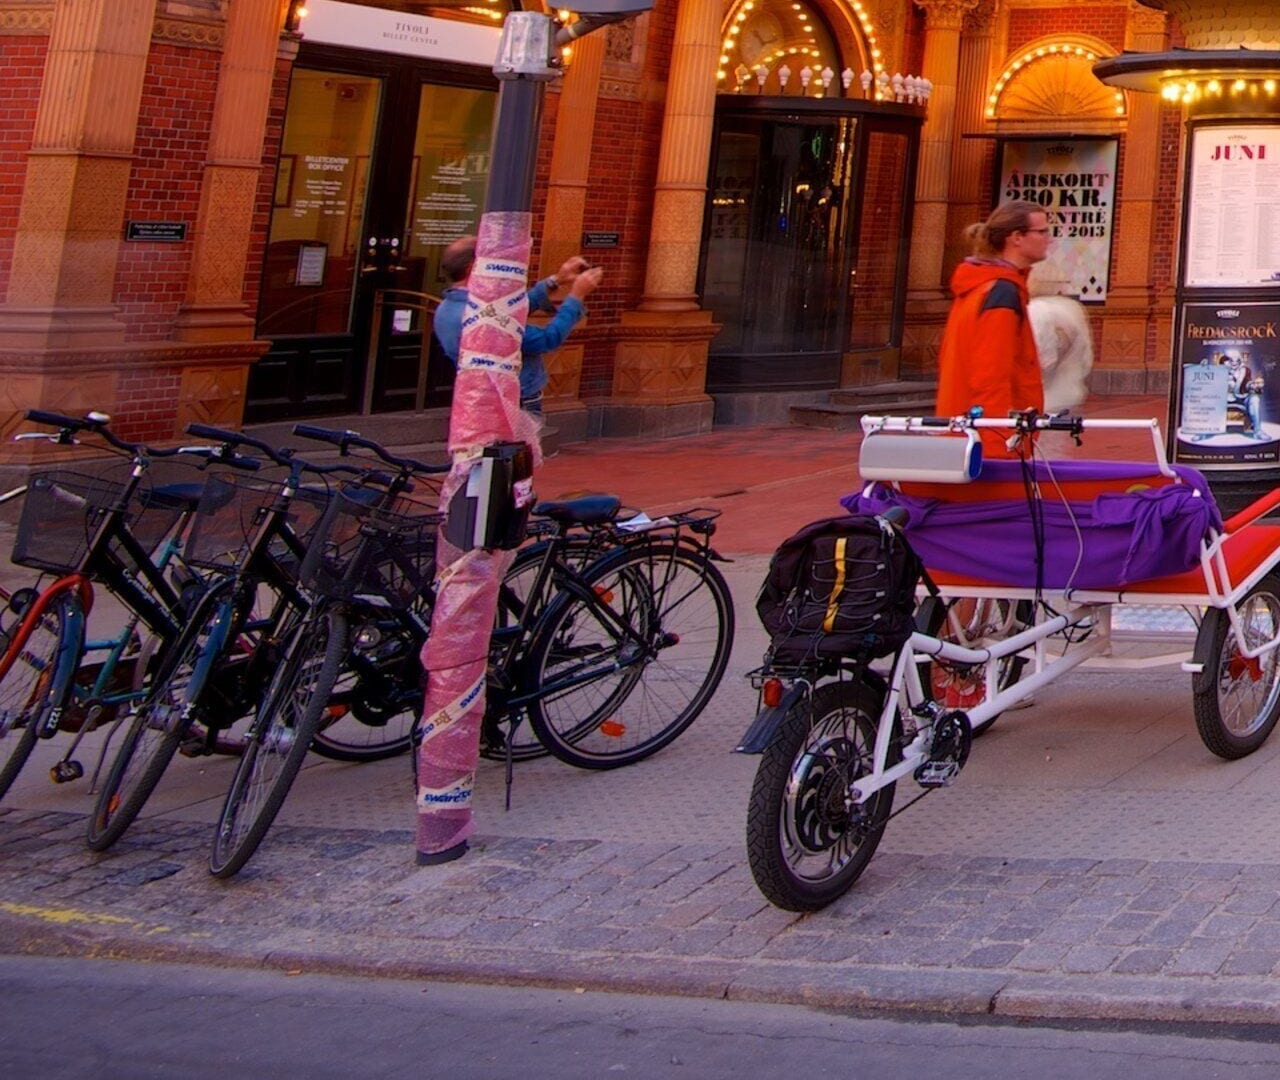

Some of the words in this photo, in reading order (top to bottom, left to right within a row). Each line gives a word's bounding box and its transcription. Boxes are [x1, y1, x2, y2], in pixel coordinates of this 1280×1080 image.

[396, 22, 429, 35] TIVOLI
[1046, 145, 1075, 154] TIVOLI
[1211, 145, 1266, 160] JUNI
[1007, 170, 1109, 188] ÅRSKORT
[1060, 189, 1107, 207] KR.
[1069, 226, 1105, 237] 2013
[1187, 321, 1277, 338] FREDAGSROCK
[1193, 372, 1215, 381] JUNI
